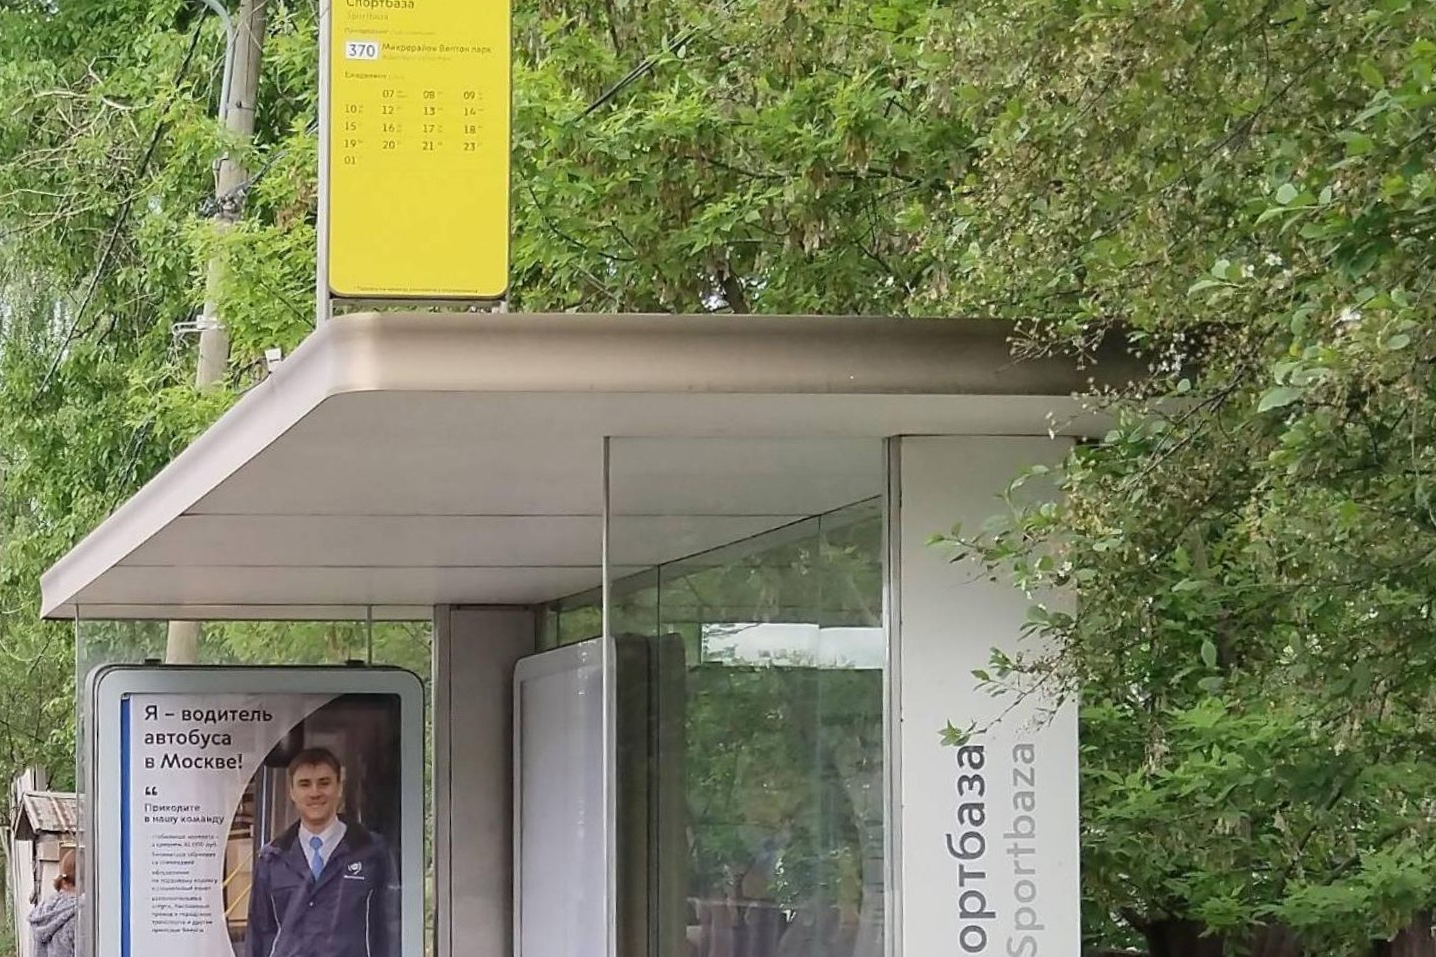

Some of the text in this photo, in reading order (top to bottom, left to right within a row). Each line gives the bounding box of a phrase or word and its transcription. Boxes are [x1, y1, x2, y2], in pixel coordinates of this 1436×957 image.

[348, 43, 376, 57] 370
[382, 89, 395, 98] 07
[423, 90, 435, 99] 08
[463, 90, 476, 100] 09
[345, 104, 357, 113] 10
[382, 105, 395, 115] 12
[423, 106, 435, 116] 13
[345, 121, 476, 135] 15 16 17 18
[344, 139, 476, 151] 19 20 21 23
[344, 155, 356, 165] 01
[144, 705, 158, 720] Я
[181, 708, 273, 724] водитель
[144, 728, 232, 749] автобуса
[144, 753, 243, 769] в Москве!
[144, 803, 201, 814] Приходите
[152, 816, 178, 825] нашу
[180, 816, 225, 825] команду
